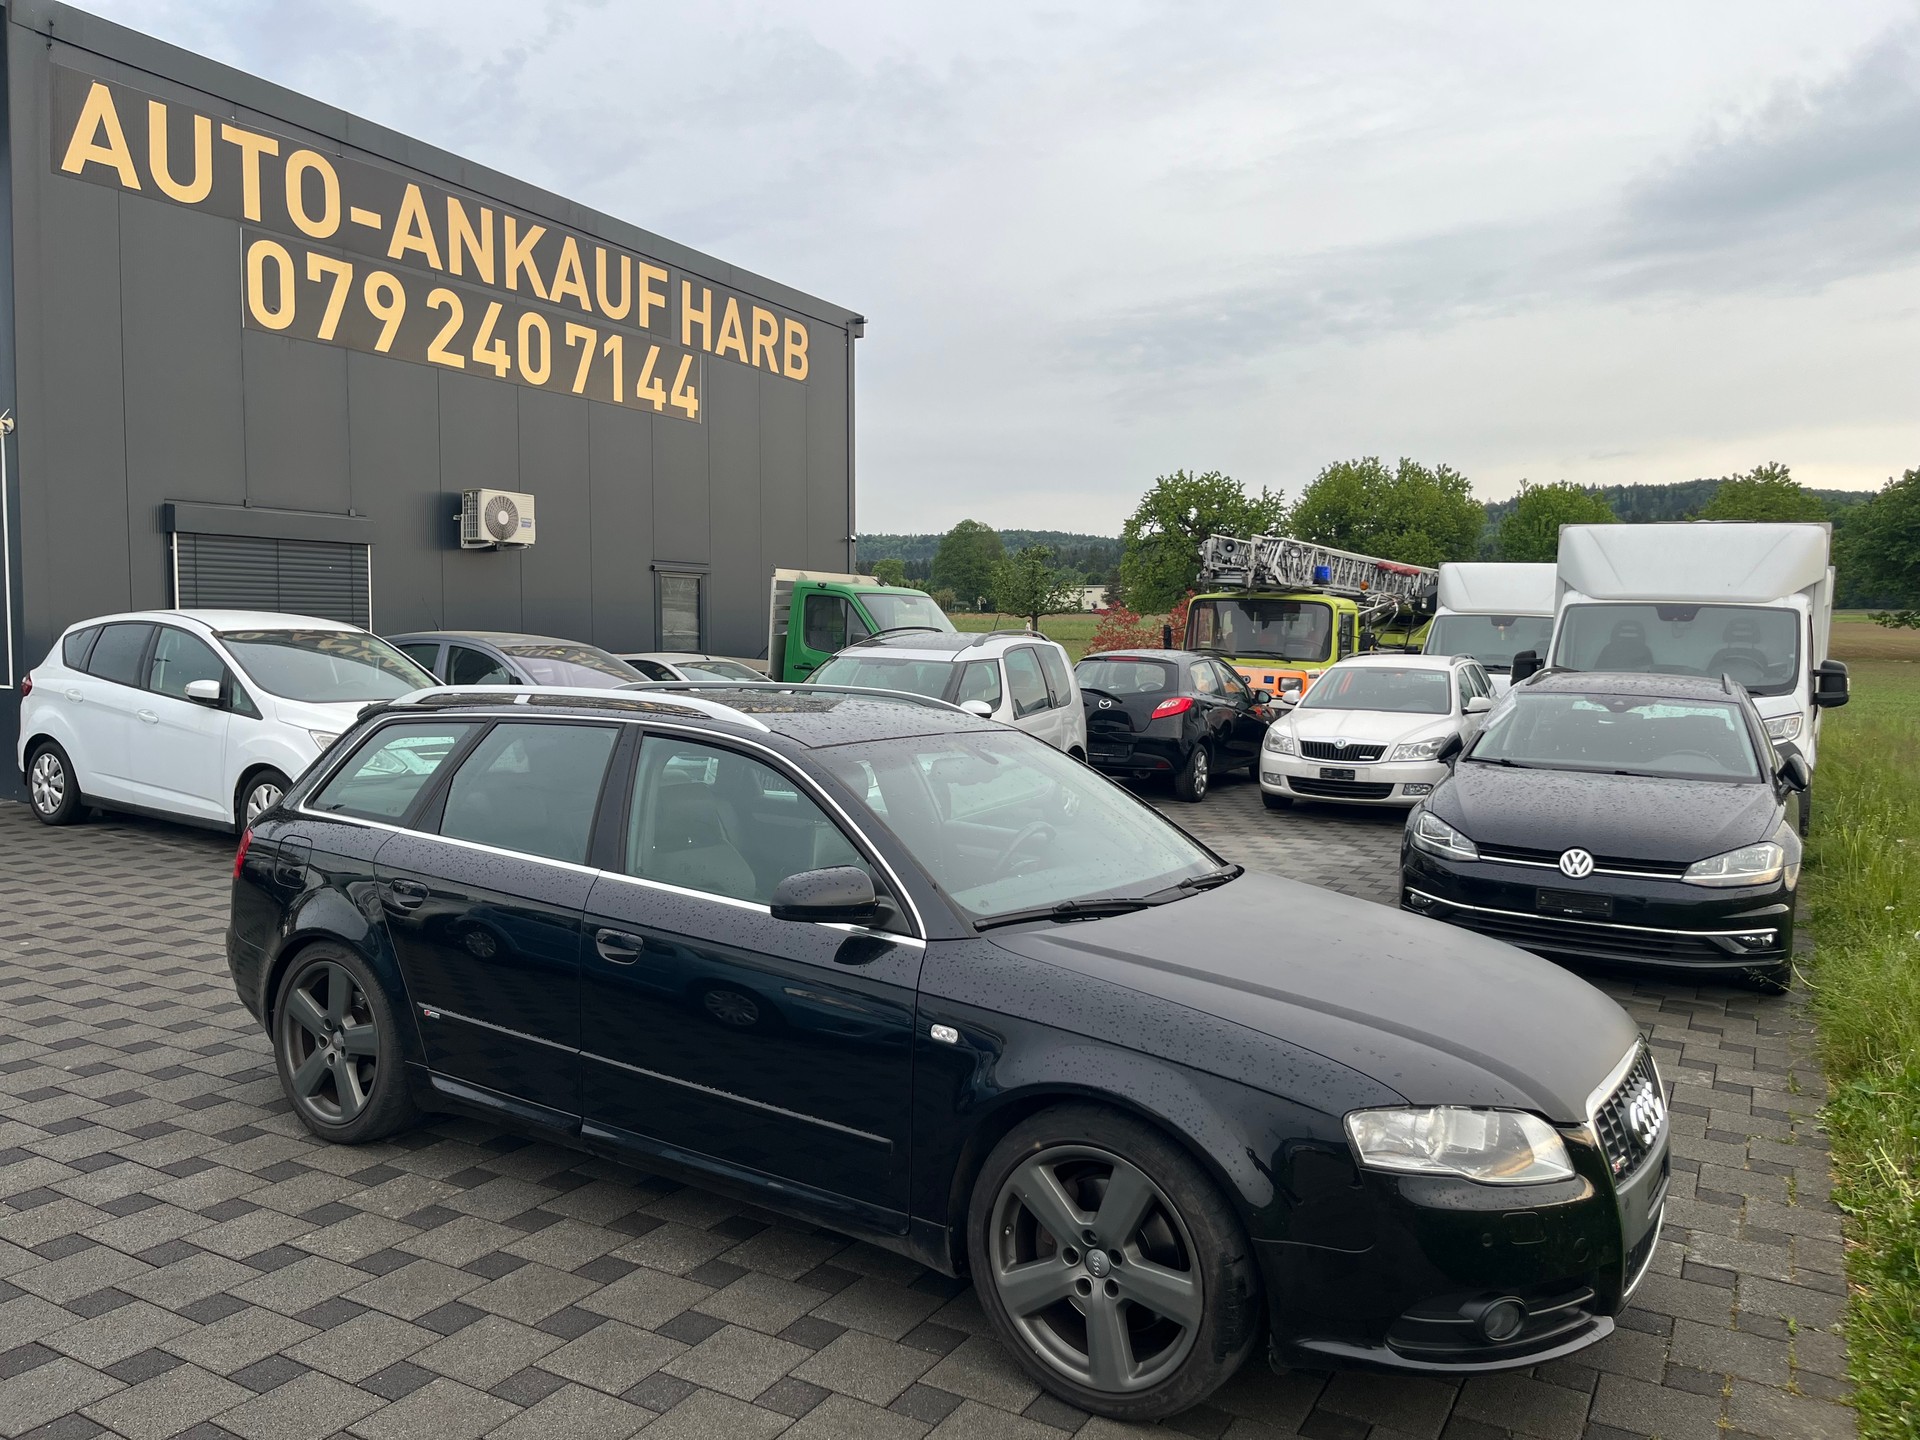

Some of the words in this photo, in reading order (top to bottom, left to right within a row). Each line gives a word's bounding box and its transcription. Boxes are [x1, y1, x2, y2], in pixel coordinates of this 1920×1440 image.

[61, 82, 668, 329] AUTO-ANKAUF
[681, 280, 809, 381] HARB
[247, 239, 407, 353] 079
[426, 287, 552, 386] 240
[565, 321, 699, 420] 7144
[1559, 848, 1594, 878] VW
